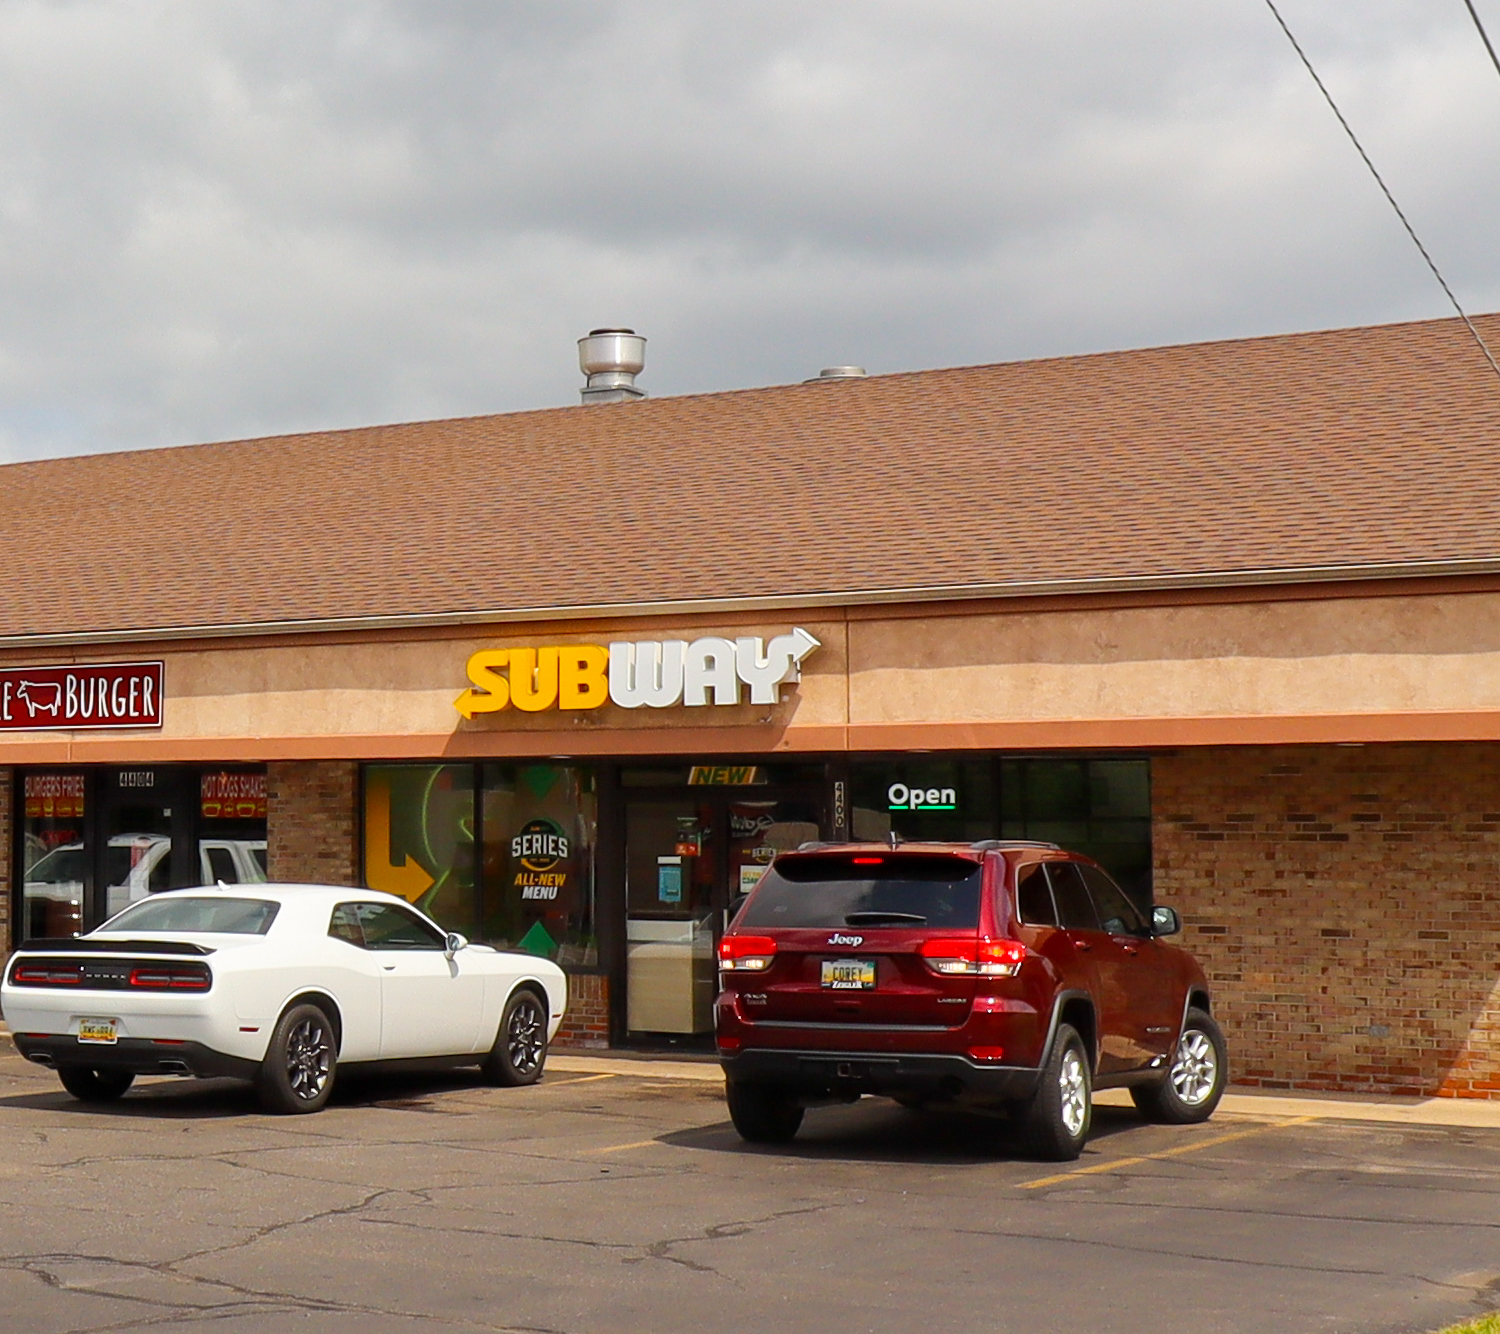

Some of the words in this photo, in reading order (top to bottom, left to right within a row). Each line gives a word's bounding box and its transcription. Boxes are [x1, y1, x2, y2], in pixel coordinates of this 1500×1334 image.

[453, 626, 822, 720] SUBWAY
[66, 674, 154, 718] BURGER
[696, 767, 748, 784] NEW
[835, 782, 844, 827] 4400
[888, 783, 956, 810] Open
[512, 834, 568, 858] SERIES
[514, 873, 566, 886] ALL-NEW
[522, 886, 558, 900] MENU
[827, 933, 863, 947] Jeep
[832, 968, 863, 981] COREY
